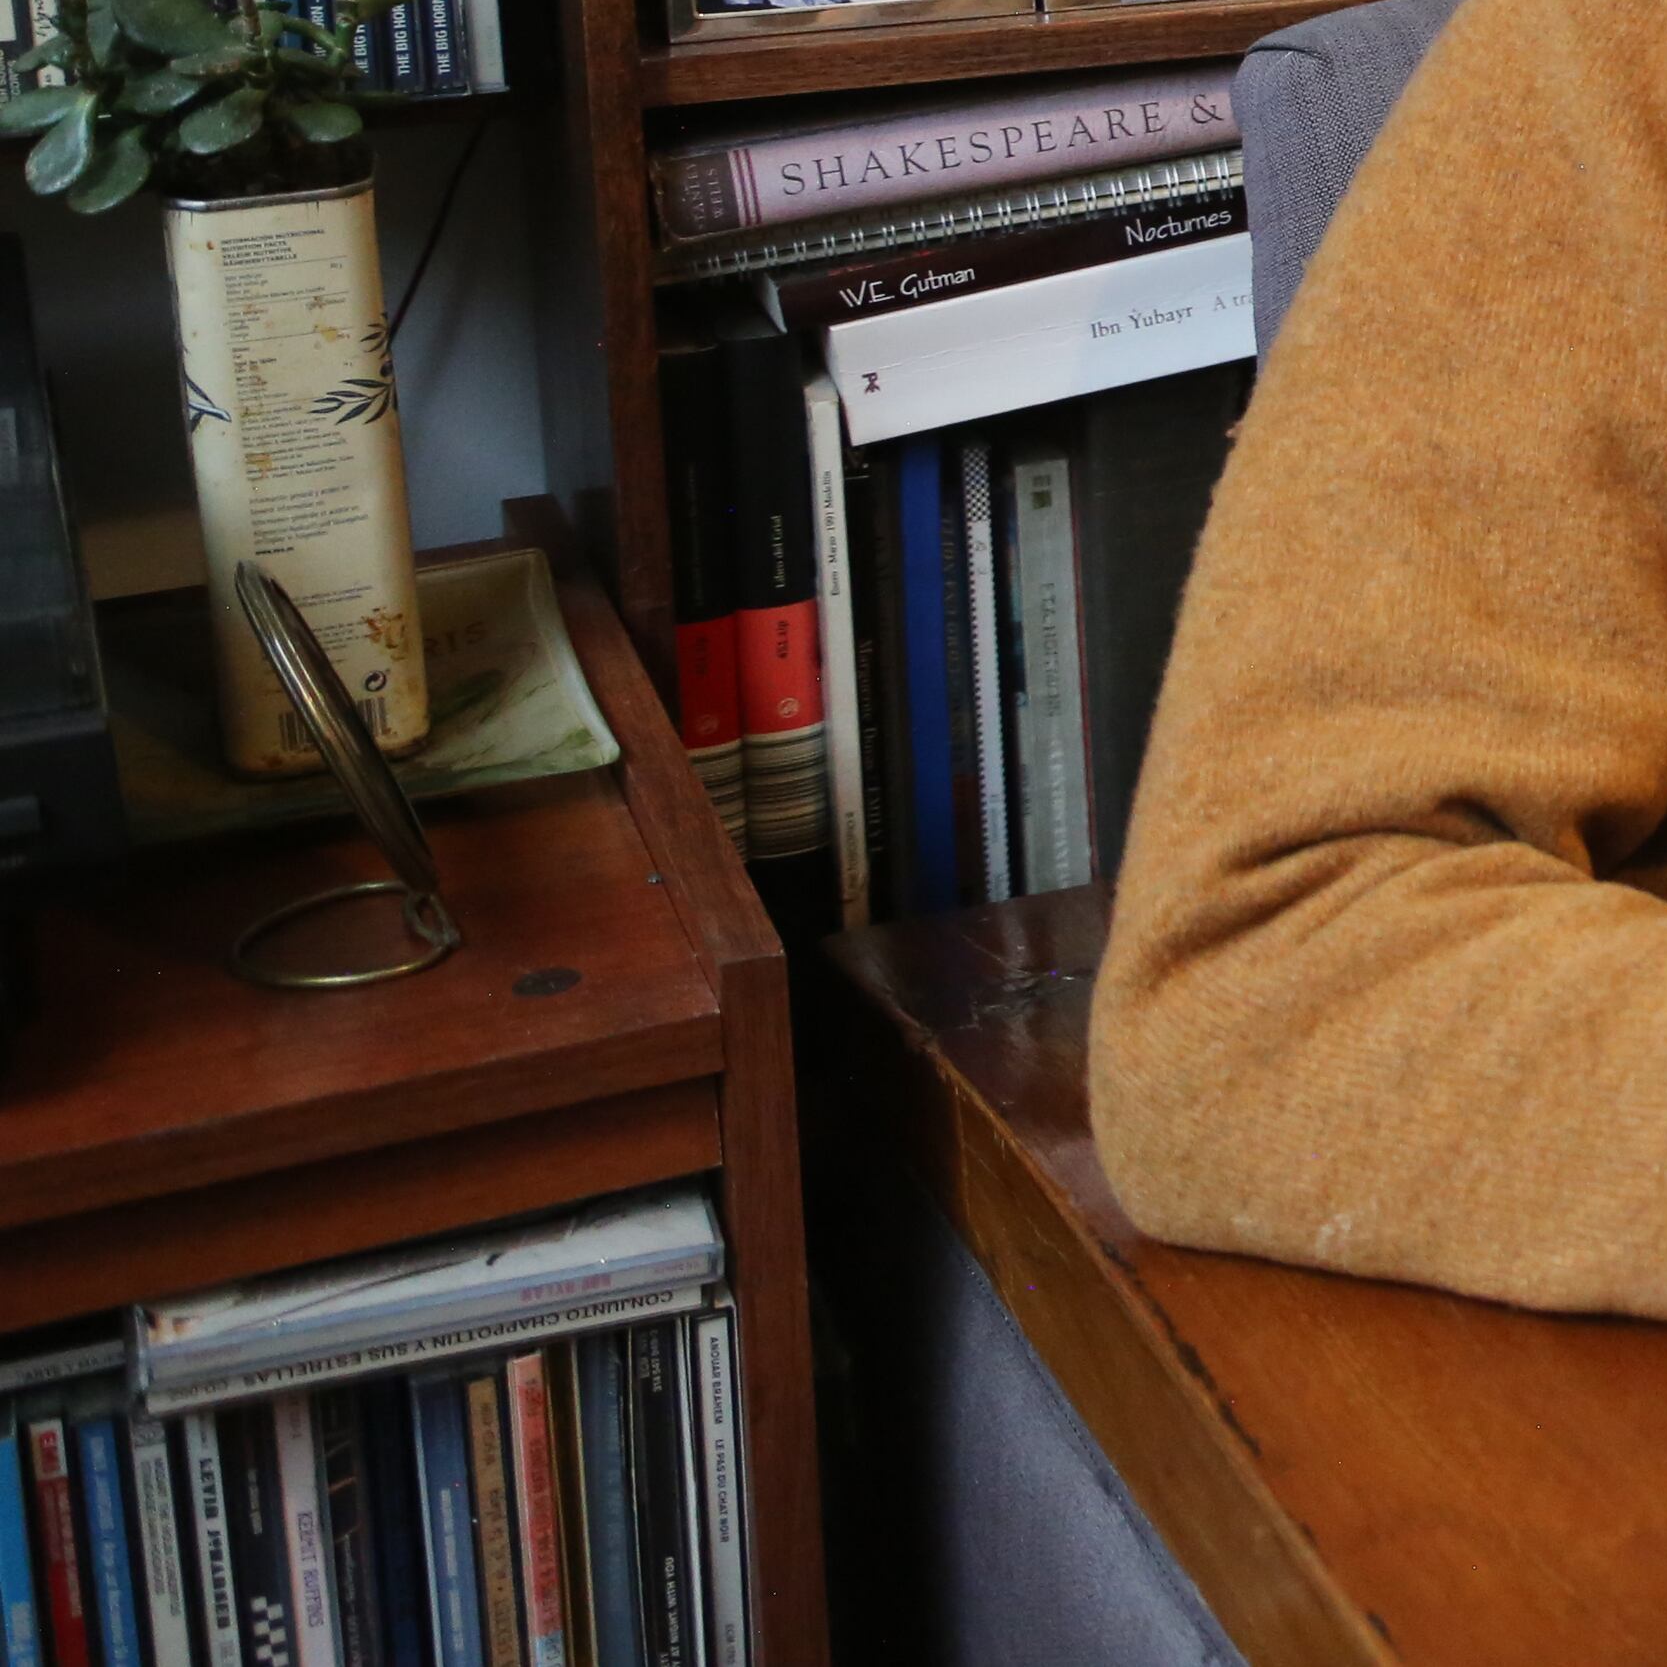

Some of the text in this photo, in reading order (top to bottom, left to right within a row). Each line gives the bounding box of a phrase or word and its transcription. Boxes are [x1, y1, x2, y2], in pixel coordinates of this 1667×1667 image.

[437, 28, 448, 48] BIG
[438, 52, 450, 74] THE
[780, 93, 1224, 197] SHAKESPEARE &
[900, 264, 976, 299] Gutman
[1125, 208, 1232, 246] Nocturnes
[1090, 318, 1121, 340] Ibn
